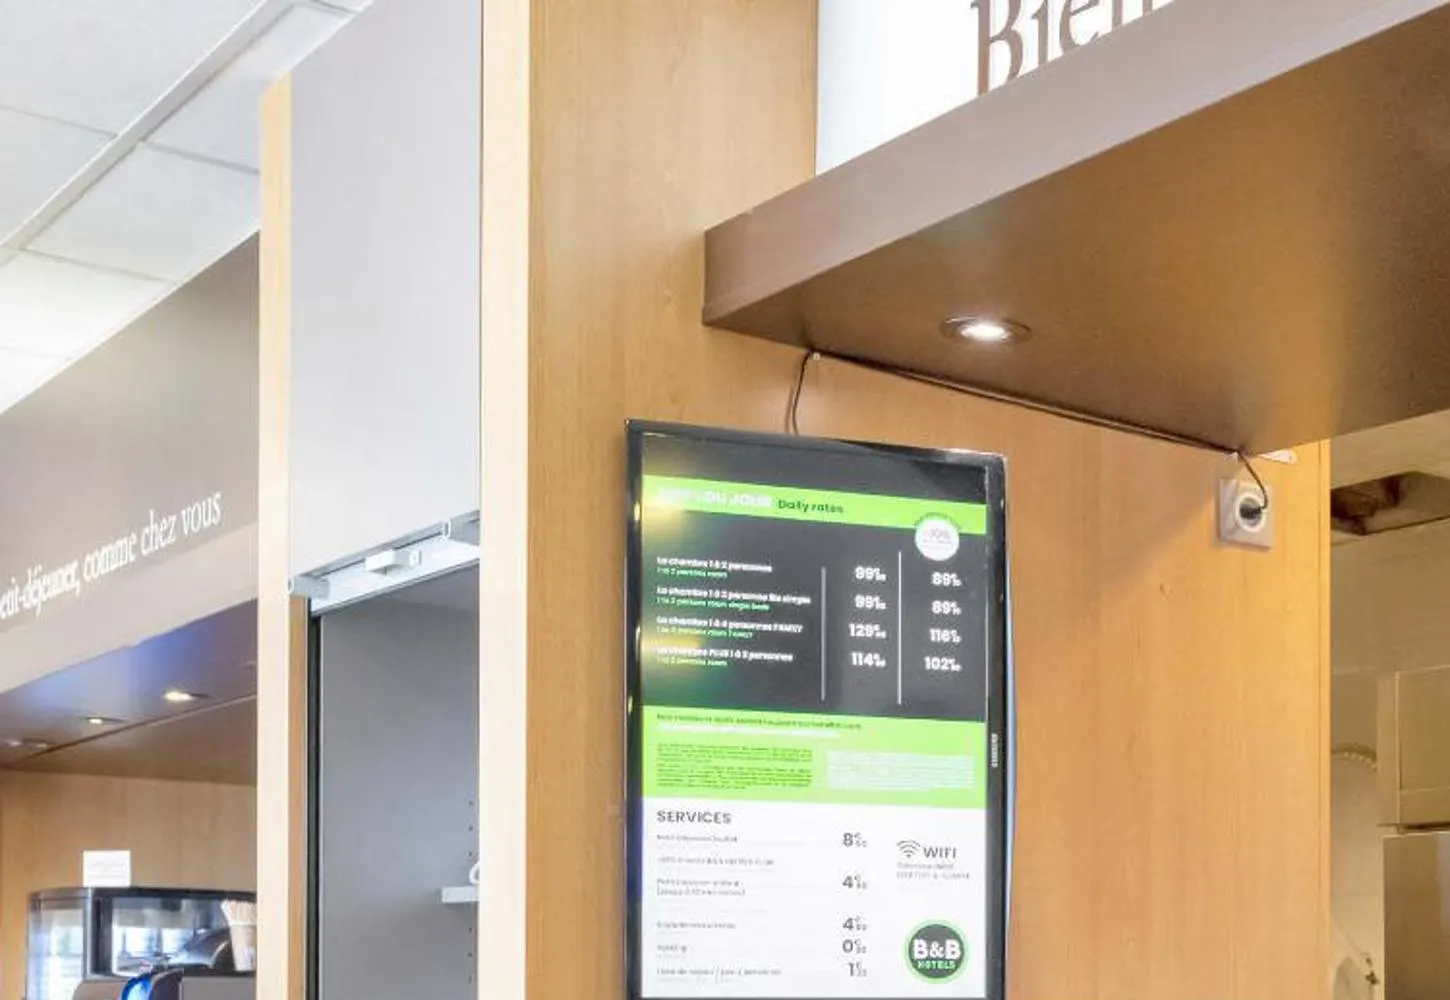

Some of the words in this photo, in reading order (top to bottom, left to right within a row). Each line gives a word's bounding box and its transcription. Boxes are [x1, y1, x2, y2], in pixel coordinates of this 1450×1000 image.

[777, 499, 809, 513] Daily
[811, 502, 845, 513] rates
[83, 530, 138, 584] comme
[140, 508, 177, 557] chez
[181, 490, 221, 537] vous
[657, 809, 732, 825] SERVICES
[923, 847, 957, 859] WIFI
[912, 938, 961, 960] B&B
[917, 960, 956, 970] HOTELS
